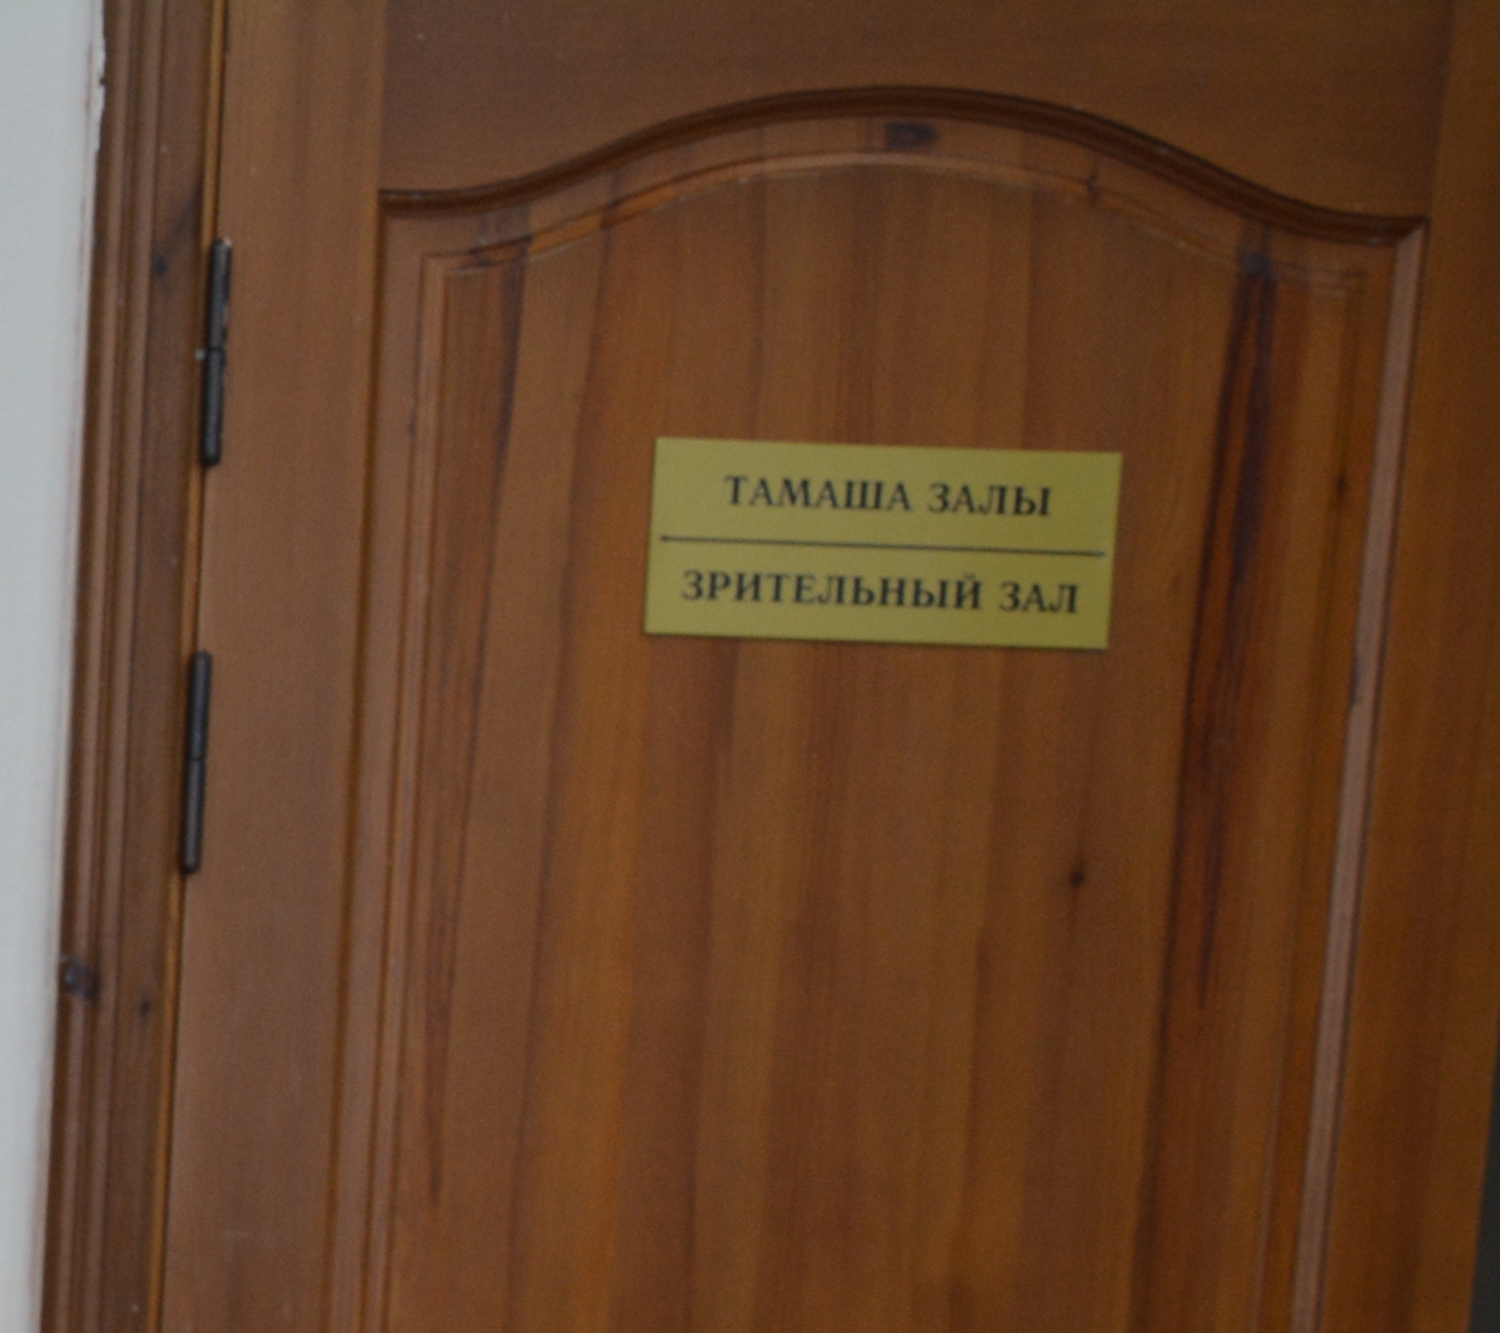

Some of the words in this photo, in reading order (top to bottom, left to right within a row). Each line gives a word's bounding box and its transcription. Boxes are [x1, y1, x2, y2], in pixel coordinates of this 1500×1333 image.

[724, 474, 913, 512] ТАМАША
[928, 482, 1052, 517] ЗАЛЫ
[682, 570, 983, 610] ЗРИТЕЛЬНЫЙ
[999, 581, 1080, 614] ЗАЛ
